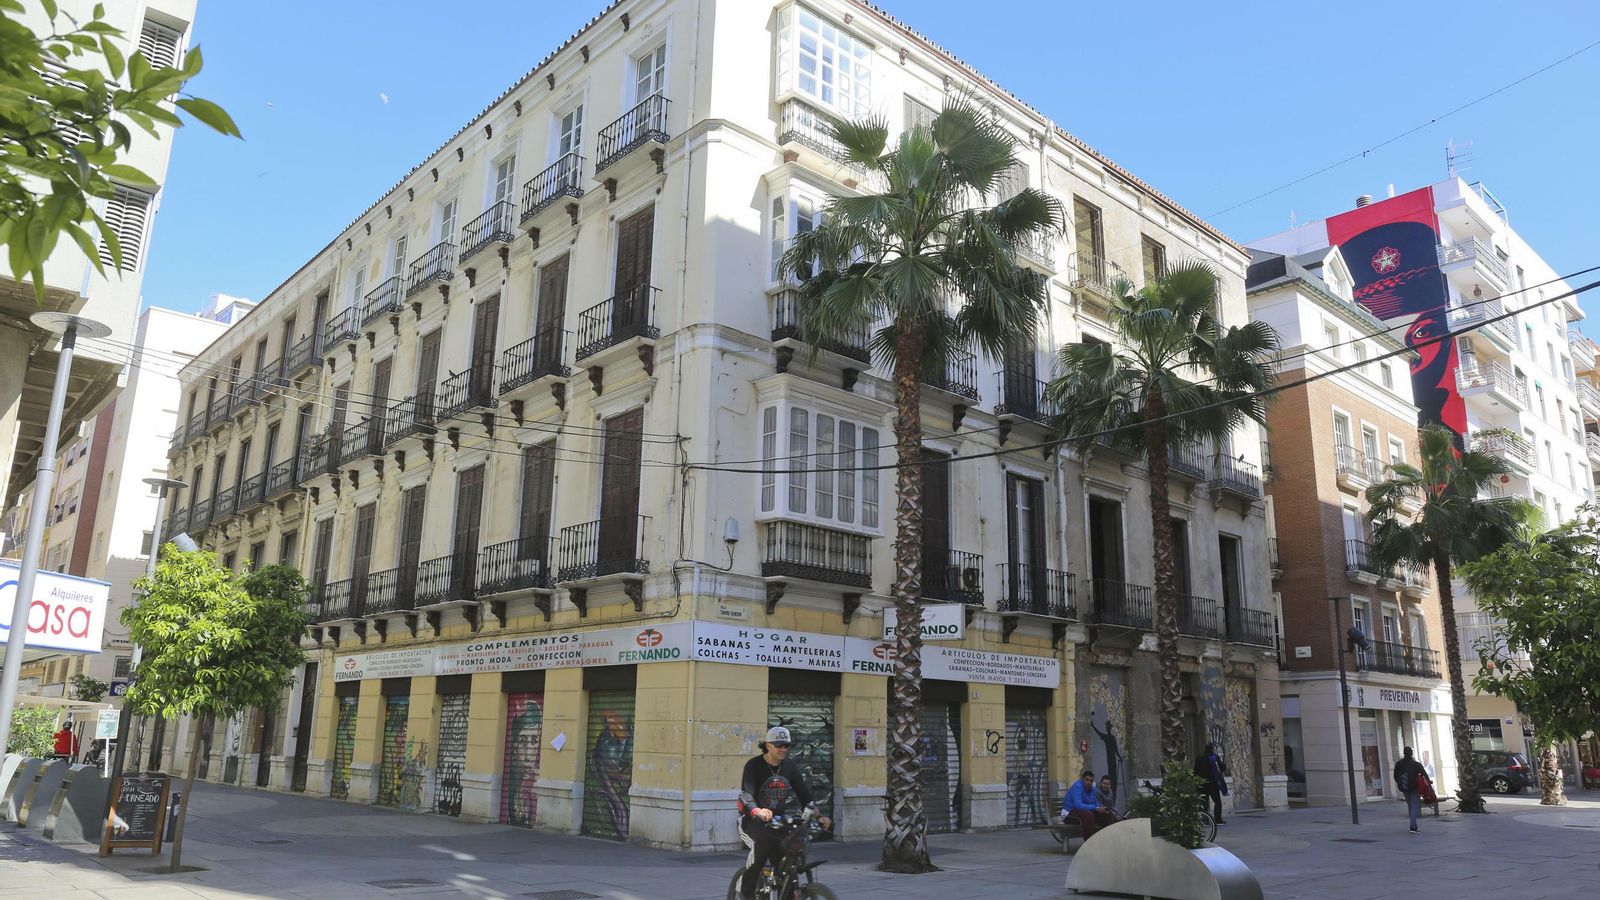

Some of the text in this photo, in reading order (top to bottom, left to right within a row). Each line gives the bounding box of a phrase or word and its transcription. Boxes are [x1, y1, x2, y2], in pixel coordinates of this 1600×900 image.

[51, 587, 93, 603] Alquileres
[0, 580, 91, 638] asa
[739, 630, 807, 644] HOGAR
[885, 624, 958, 636] FANDO
[467, 635, 579, 652] COMPLEMENTOS
[698, 637, 841, 657] SABANAS MANTELERIAS
[528, 651, 581, 661] CONFECCION
[618, 647, 680, 661] FERNANDO
[698, 649, 840, 668] COLCHAS TOALLAS MANTAS
[941, 649, 986, 660] ARTICULOS
[1004, 655, 1056, 666] IMPORTACION
[852, 660, 897, 674] FERNA
[335, 670, 363, 680] FERNANDO
[1380, 689, 1420, 703] PREVENTIVA
